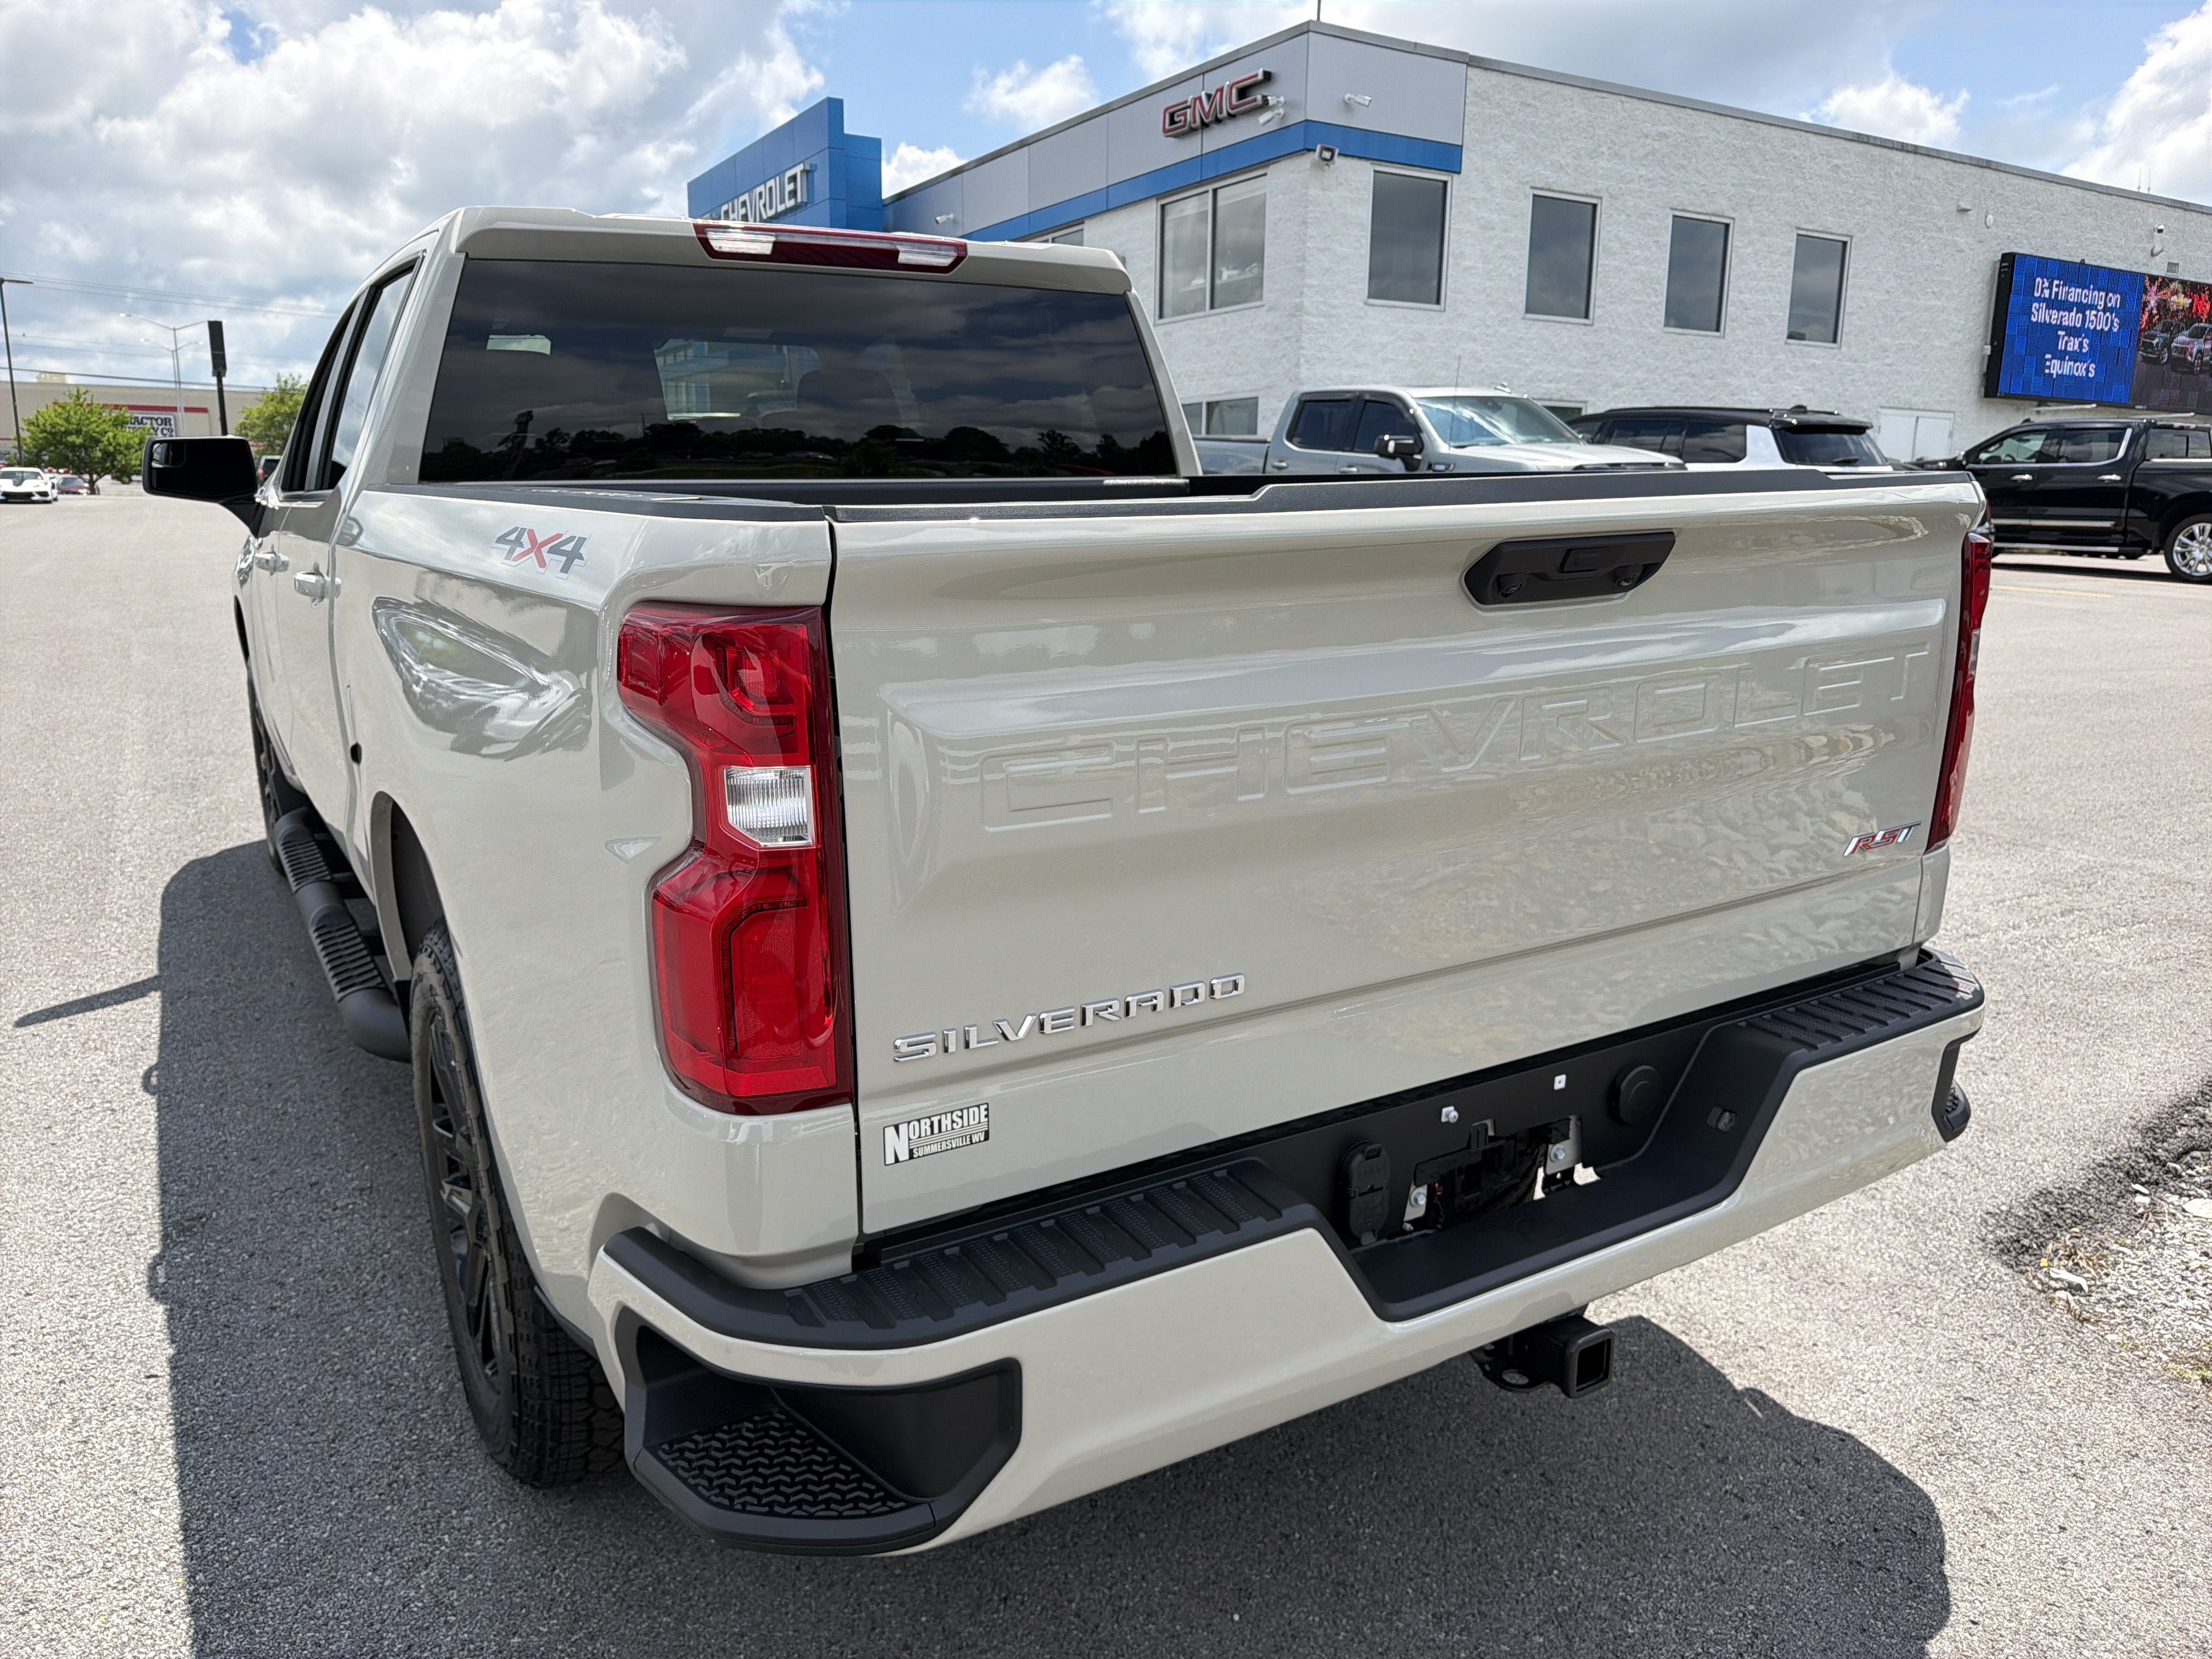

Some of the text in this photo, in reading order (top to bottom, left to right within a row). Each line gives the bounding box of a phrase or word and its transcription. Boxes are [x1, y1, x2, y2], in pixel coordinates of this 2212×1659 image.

[1162, 67, 1271, 137] GMC
[721, 163, 810, 223] CHEVROLET
[2052, 280, 2106, 310] Financing
[2107, 292, 2121, 309] on
[2031, 302, 2120, 332] Silverado 1500's
[2058, 330, 2090, 353] Trax's
[2045, 354, 2096, 378] Equinox's
[980, 642, 1929, 833] CHEVROLET
[1843, 821, 1922, 856] RST
[893, 972, 1245, 1063] SILVERADO
[884, 1104, 988, 1165] NORTHSIDE
[912, 1131, 985, 1158] SUMMERSVILLE WV
